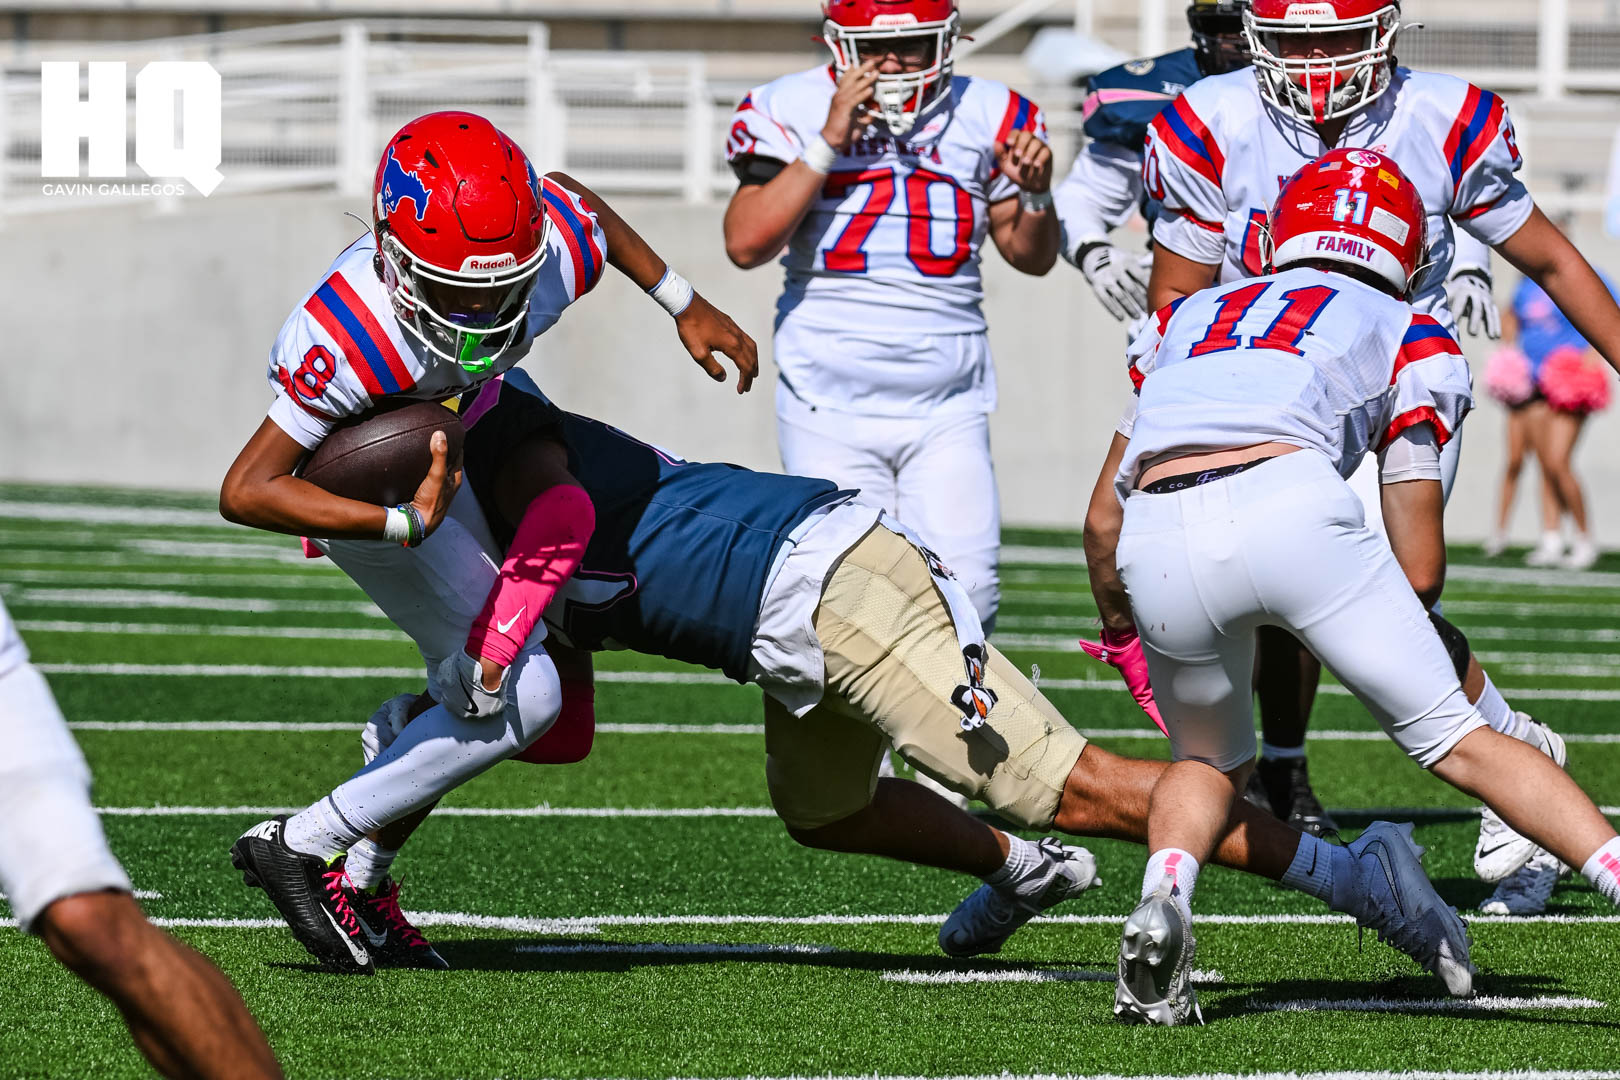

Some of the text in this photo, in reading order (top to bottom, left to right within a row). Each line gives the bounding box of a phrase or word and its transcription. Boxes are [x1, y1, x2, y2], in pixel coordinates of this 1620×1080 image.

[822, 165, 975, 279] 70
[1332, 188, 1369, 226] 11
[470, 256, 512, 270] Riddell
[1315, 235, 1377, 263] FAMILY
[1185, 280, 1341, 360] 11
[292, 344, 337, 401] 8
